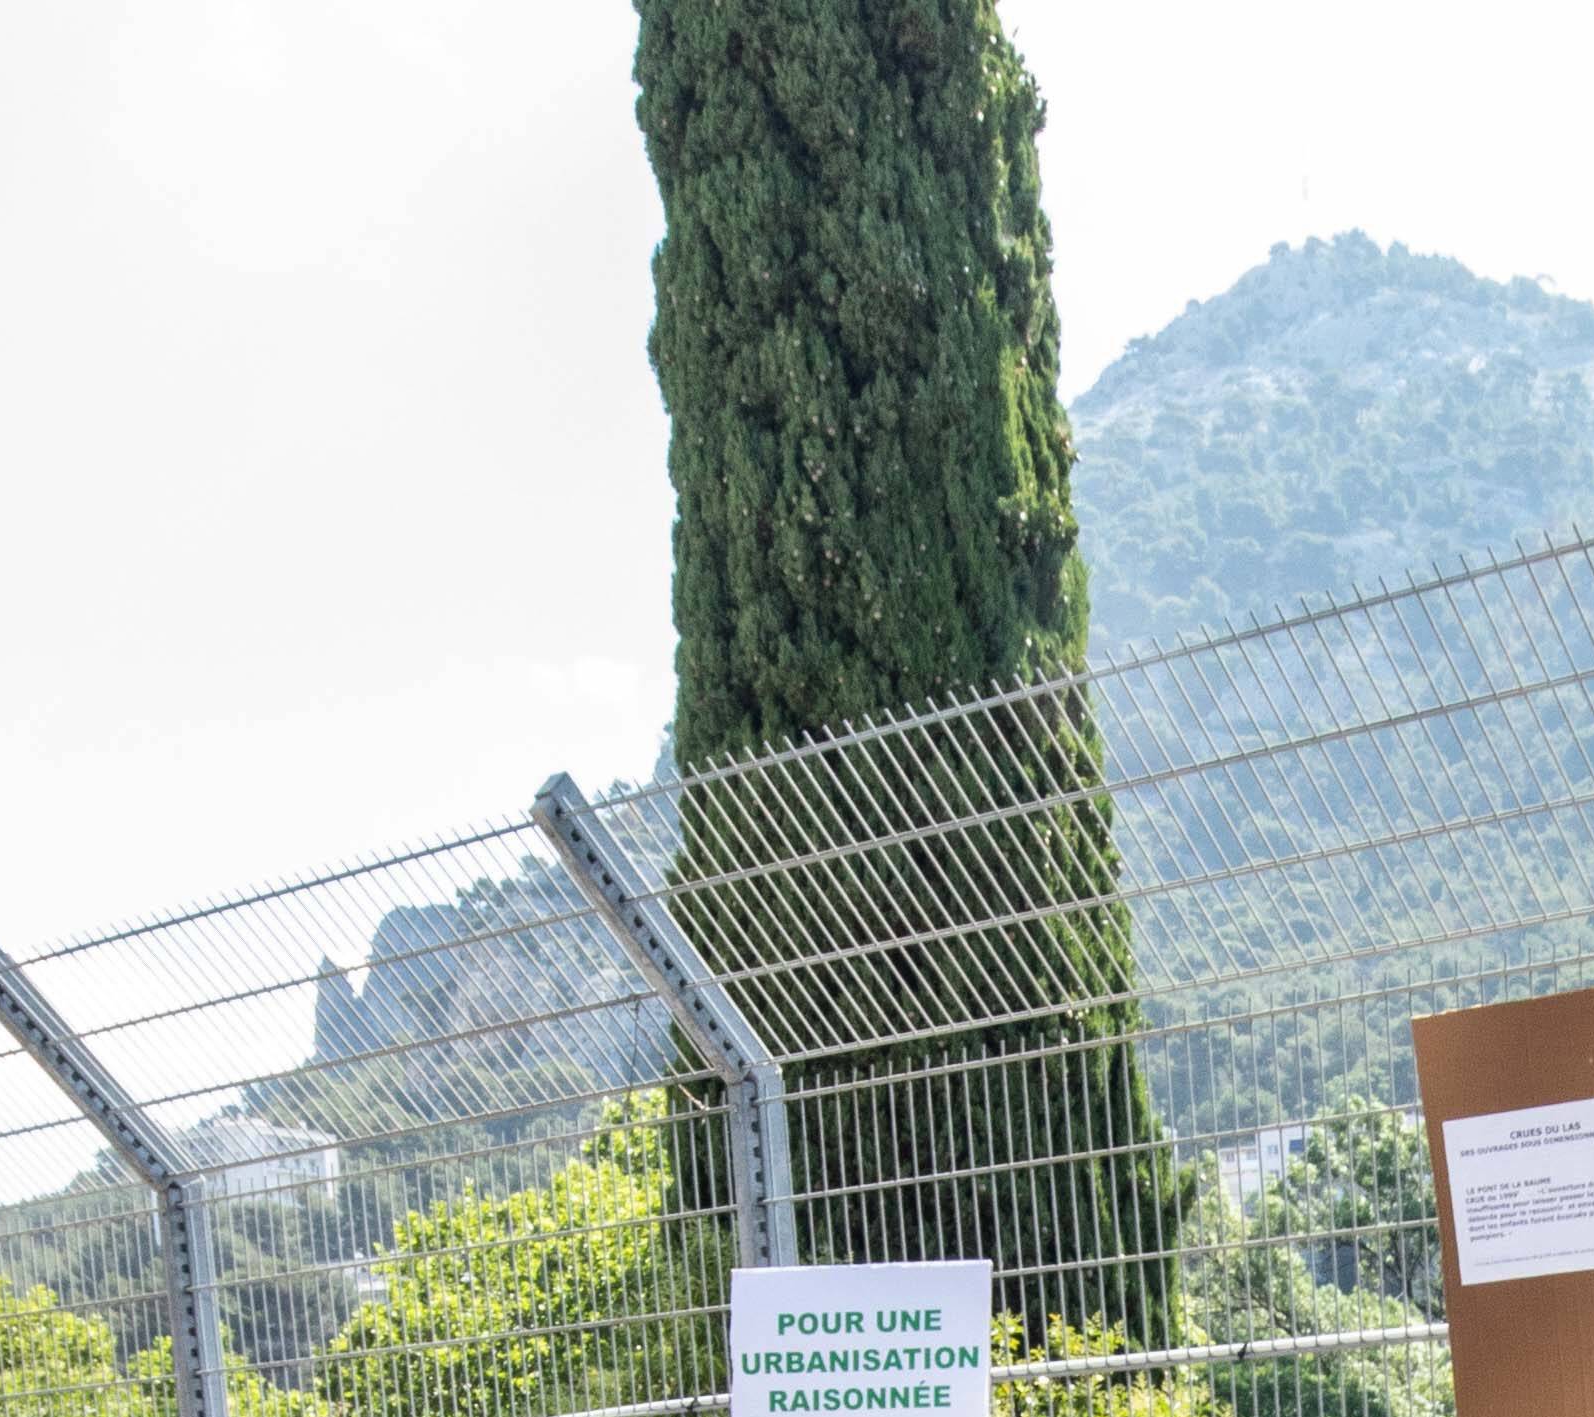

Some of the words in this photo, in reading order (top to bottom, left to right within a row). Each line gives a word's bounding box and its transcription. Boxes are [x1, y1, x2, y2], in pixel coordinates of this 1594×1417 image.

[1510, 1128, 1542, 1140] CRUES
[1545, 1125, 1560, 1135] DU
[1562, 1121, 1581, 1132] LAS
[777, 1311, 865, 1336] POUR
[876, 1309, 942, 1333] UNE
[741, 1346, 979, 1375] URBANISATION
[769, 1381, 951, 1412] RAISONNÉE
